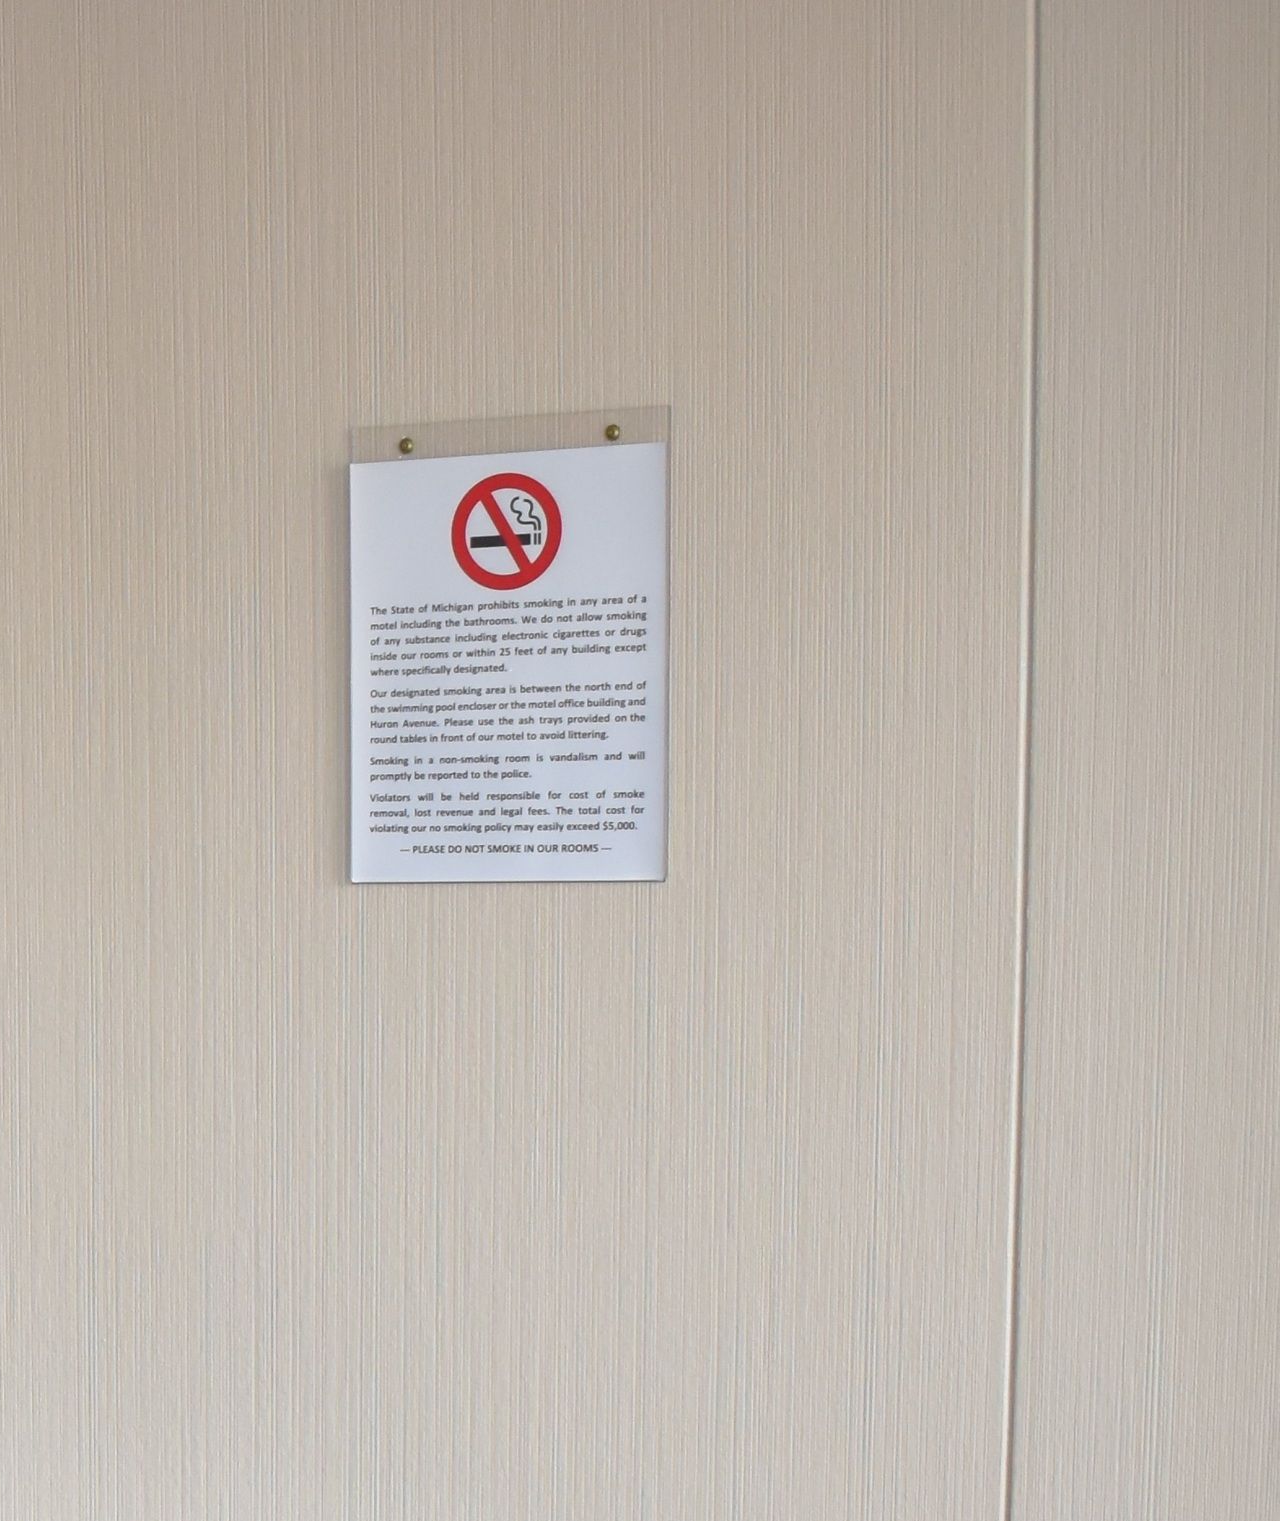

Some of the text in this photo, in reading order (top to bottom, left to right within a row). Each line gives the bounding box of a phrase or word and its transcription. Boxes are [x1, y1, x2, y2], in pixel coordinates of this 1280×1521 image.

[371, 607, 387, 615] The
[391, 606, 414, 614] State
[418, 605, 428, 613] of
[432, 604, 473, 613] Michigan
[478, 600, 519, 611] prohibits
[524, 598, 563, 608] smoking
[568, 598, 576, 606] in
[580, 598, 597, 606] any
[602, 596, 622, 604] area
[628, 594, 637, 604] of
[371, 611, 646, 630] motel including the bathrooms. We do not allow smoking
[371, 637, 380, 645] of
[384, 638, 400, 646] any
[405, 635, 450, 644] substance
[455, 632, 497, 642] including
[502, 631, 548, 640] electronic
[553, 629, 600, 639] cigarettes
[620, 628, 646, 636] drugs
[371, 652, 396, 661] inside
[420, 651, 448, 659] rooms
[466, 648, 495, 657] within
[499, 648, 510, 656] 25
[515, 647, 533, 655] feet
[538, 646, 547, 654] of
[551, 647, 568, 656] any
[572, 644, 610, 654] building
[615, 644, 646, 653] except
[371, 663, 507, 676] where specifically designated.
[370, 681, 646, 698] Our designated smoking area is between the north end of
[370, 697, 646, 713] the swimming pool encloser or the motel office building and
[370, 720, 398, 728] Huron
[402, 719, 439, 728] Avenue.
[444, 718, 473, 726] Please
[499, 717, 514, 725] the
[518, 716, 534, 724] ash
[540, 716, 562, 725] trays
[568, 714, 610, 724] provided
[615, 714, 627, 722] on
[630, 713, 645, 721] the
[370, 735, 397, 744] round
[400, 734, 426, 743] tables
[430, 734, 438, 742] in
[441, 733, 463, 742] front
[466, 732, 475, 741] of
[478, 733, 494, 741] our
[497, 732, 524, 740] motel
[540, 731, 565, 739] avoid
[568, 730, 608, 740] littering.
[370, 757, 408, 766] Smoking
[414, 756, 422, 764] in
[440, 755, 499, 764] non-smoking
[536, 754, 543, 762] is
[550, 752, 598, 762] vandalism
[604, 752, 622, 760] and
[628, 751, 645, 759] will
[370, 769, 532, 782] promptly be reported to the police.
[370, 789, 645, 802] Violators will be held responsible for cost of smoke
[370, 809, 409, 818] removal,
[415, 808, 431, 816] lost
[478, 808, 495, 816] and
[501, 807, 522, 817] legal
[528, 807, 550, 815] fees.
[556, 806, 573, 815] The
[578, 806, 600, 814] total
[606, 806, 625, 814] cost
[631, 805, 644, 814] for
[370, 824, 408, 834] violating
[444, 823, 482, 833] smoking
[484, 822, 511, 832] policy
[514, 824, 534, 832] may
[537, 822, 563, 832] easily
[567, 822, 600, 830] exceed
[603, 821, 637, 831] $5,000.
[412, 844, 598, 854] PLEASE DO NOT SMOKE IN OUR ROOMS
